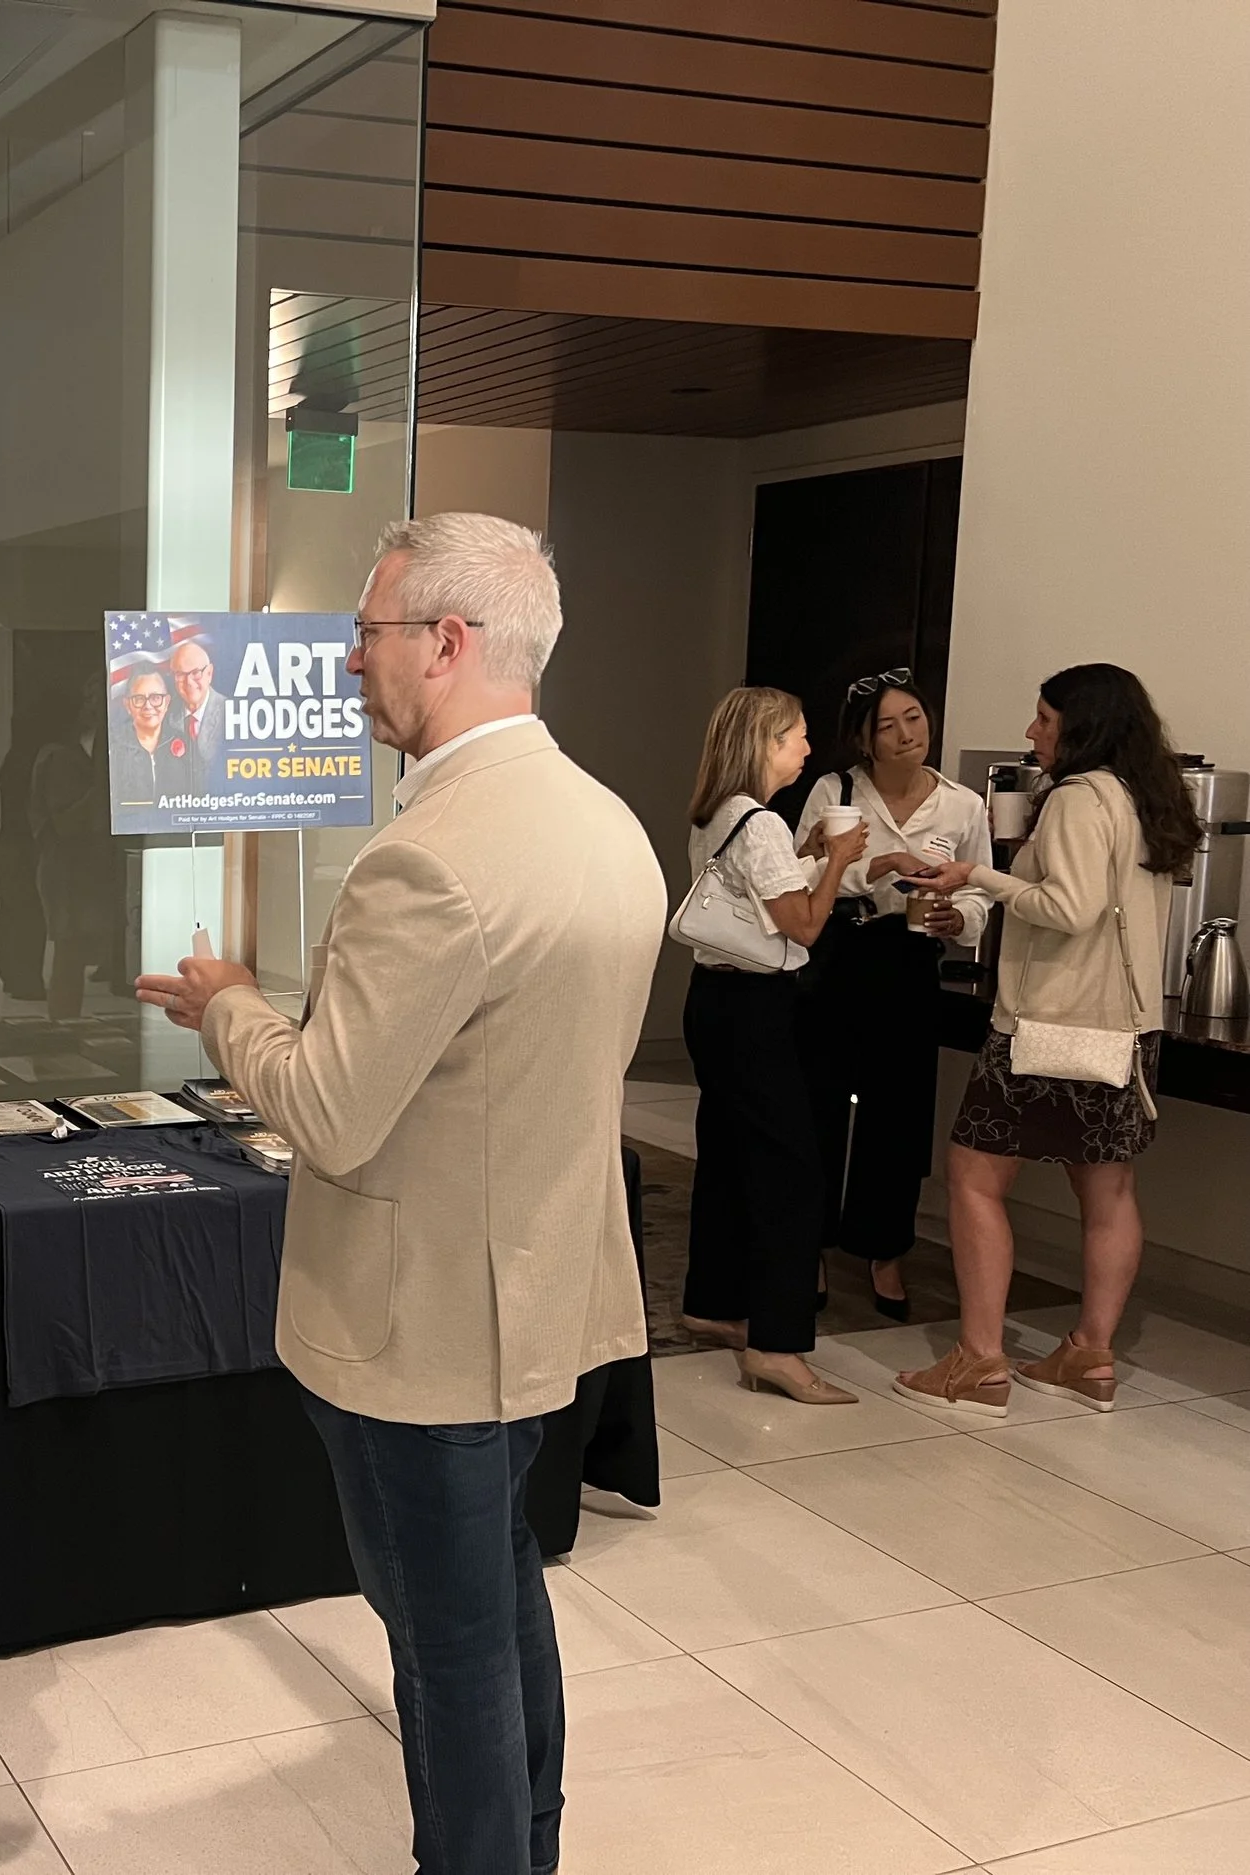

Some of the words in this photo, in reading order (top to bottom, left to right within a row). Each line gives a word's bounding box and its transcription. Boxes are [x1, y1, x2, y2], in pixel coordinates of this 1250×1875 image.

[233, 642, 346, 697] ART
[225, 698, 364, 741] HODGES
[227, 758, 271, 779] FOR
[278, 756, 362, 778] SENATE
[158, 792, 336, 810] ArtHodgesForSenate.com
